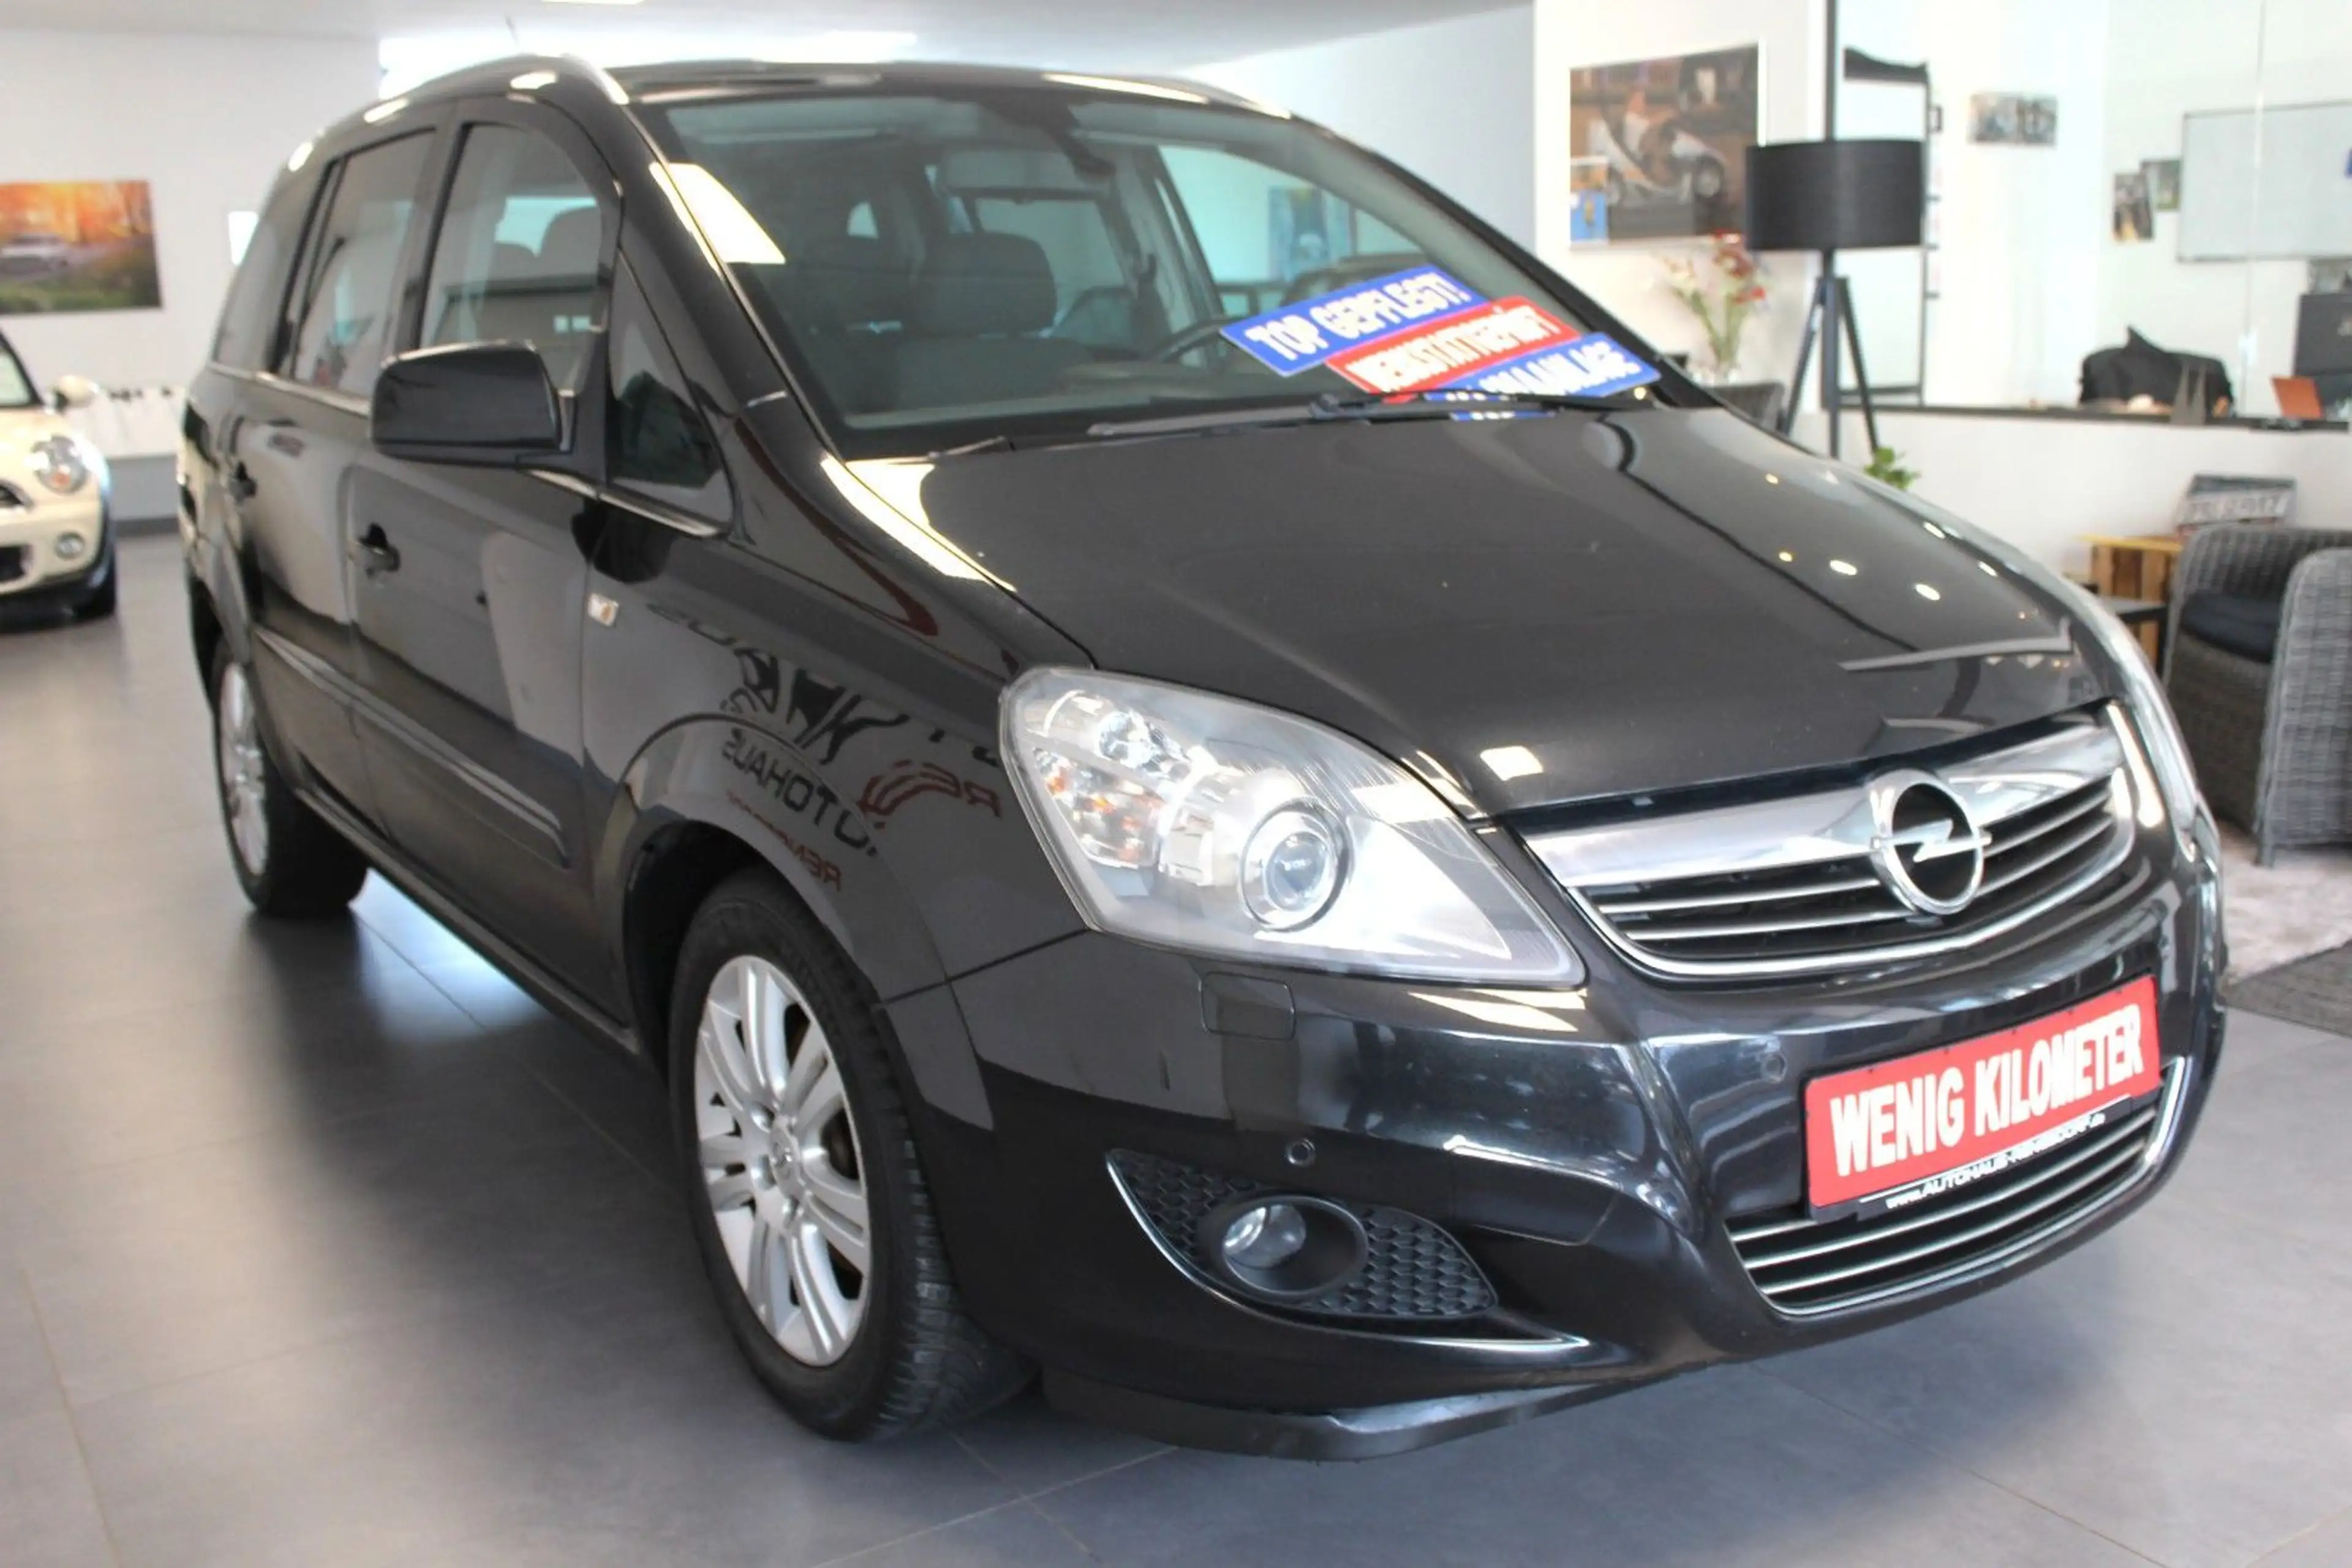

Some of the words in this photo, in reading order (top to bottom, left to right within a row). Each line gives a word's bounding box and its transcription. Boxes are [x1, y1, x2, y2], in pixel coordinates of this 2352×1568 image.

[1245, 314, 1329, 361] TOP
[1830, 1066, 1964, 1177] WENIG
[1973, 1003, 2144, 1137] KILOMETER
